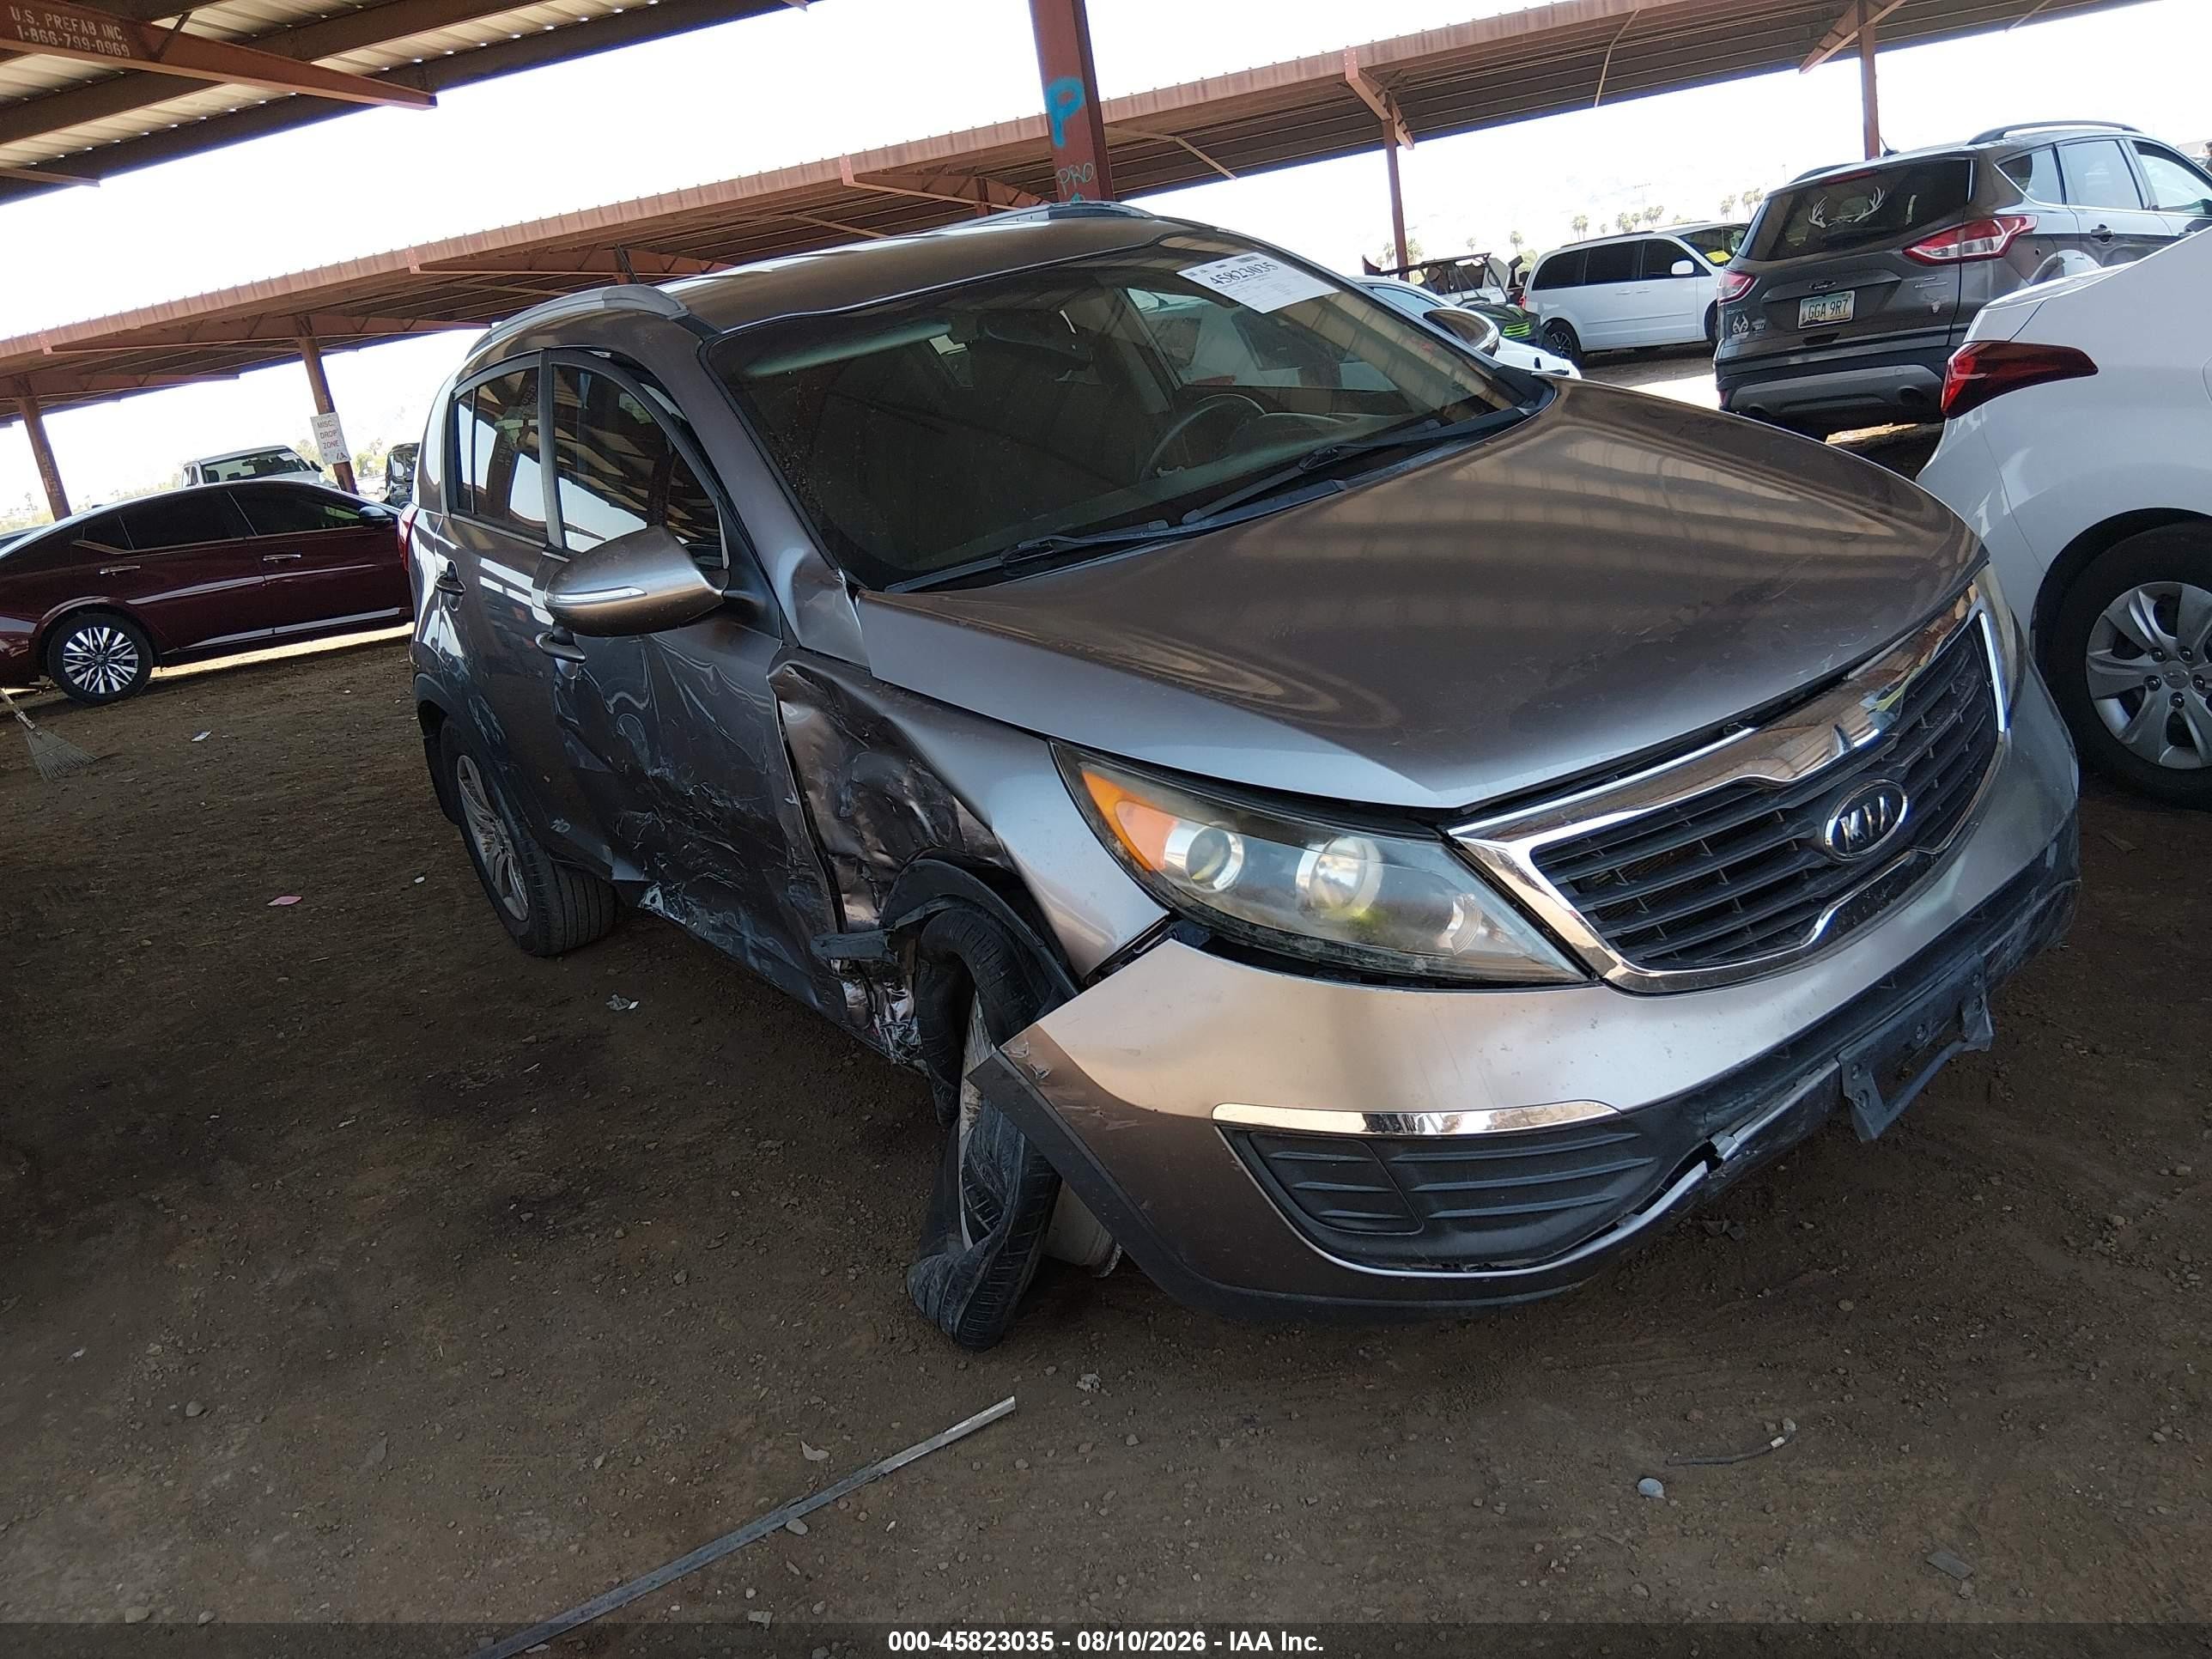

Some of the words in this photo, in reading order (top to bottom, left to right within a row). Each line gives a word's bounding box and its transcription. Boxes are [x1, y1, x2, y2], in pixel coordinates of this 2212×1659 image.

[9, 6, 40, 26] U.S.
[45, 13, 97, 36] PREFAB
[101, 23, 127, 41] INC.
[1046, 76, 1085, 149] P
[1209, 262, 1279, 285] 45823035
[1830, 299, 1849, 316] 9R7
[319, 430, 337, 439] DROP
[323, 440, 339, 449] ZONE
[1839, 795, 1894, 850] KIA
